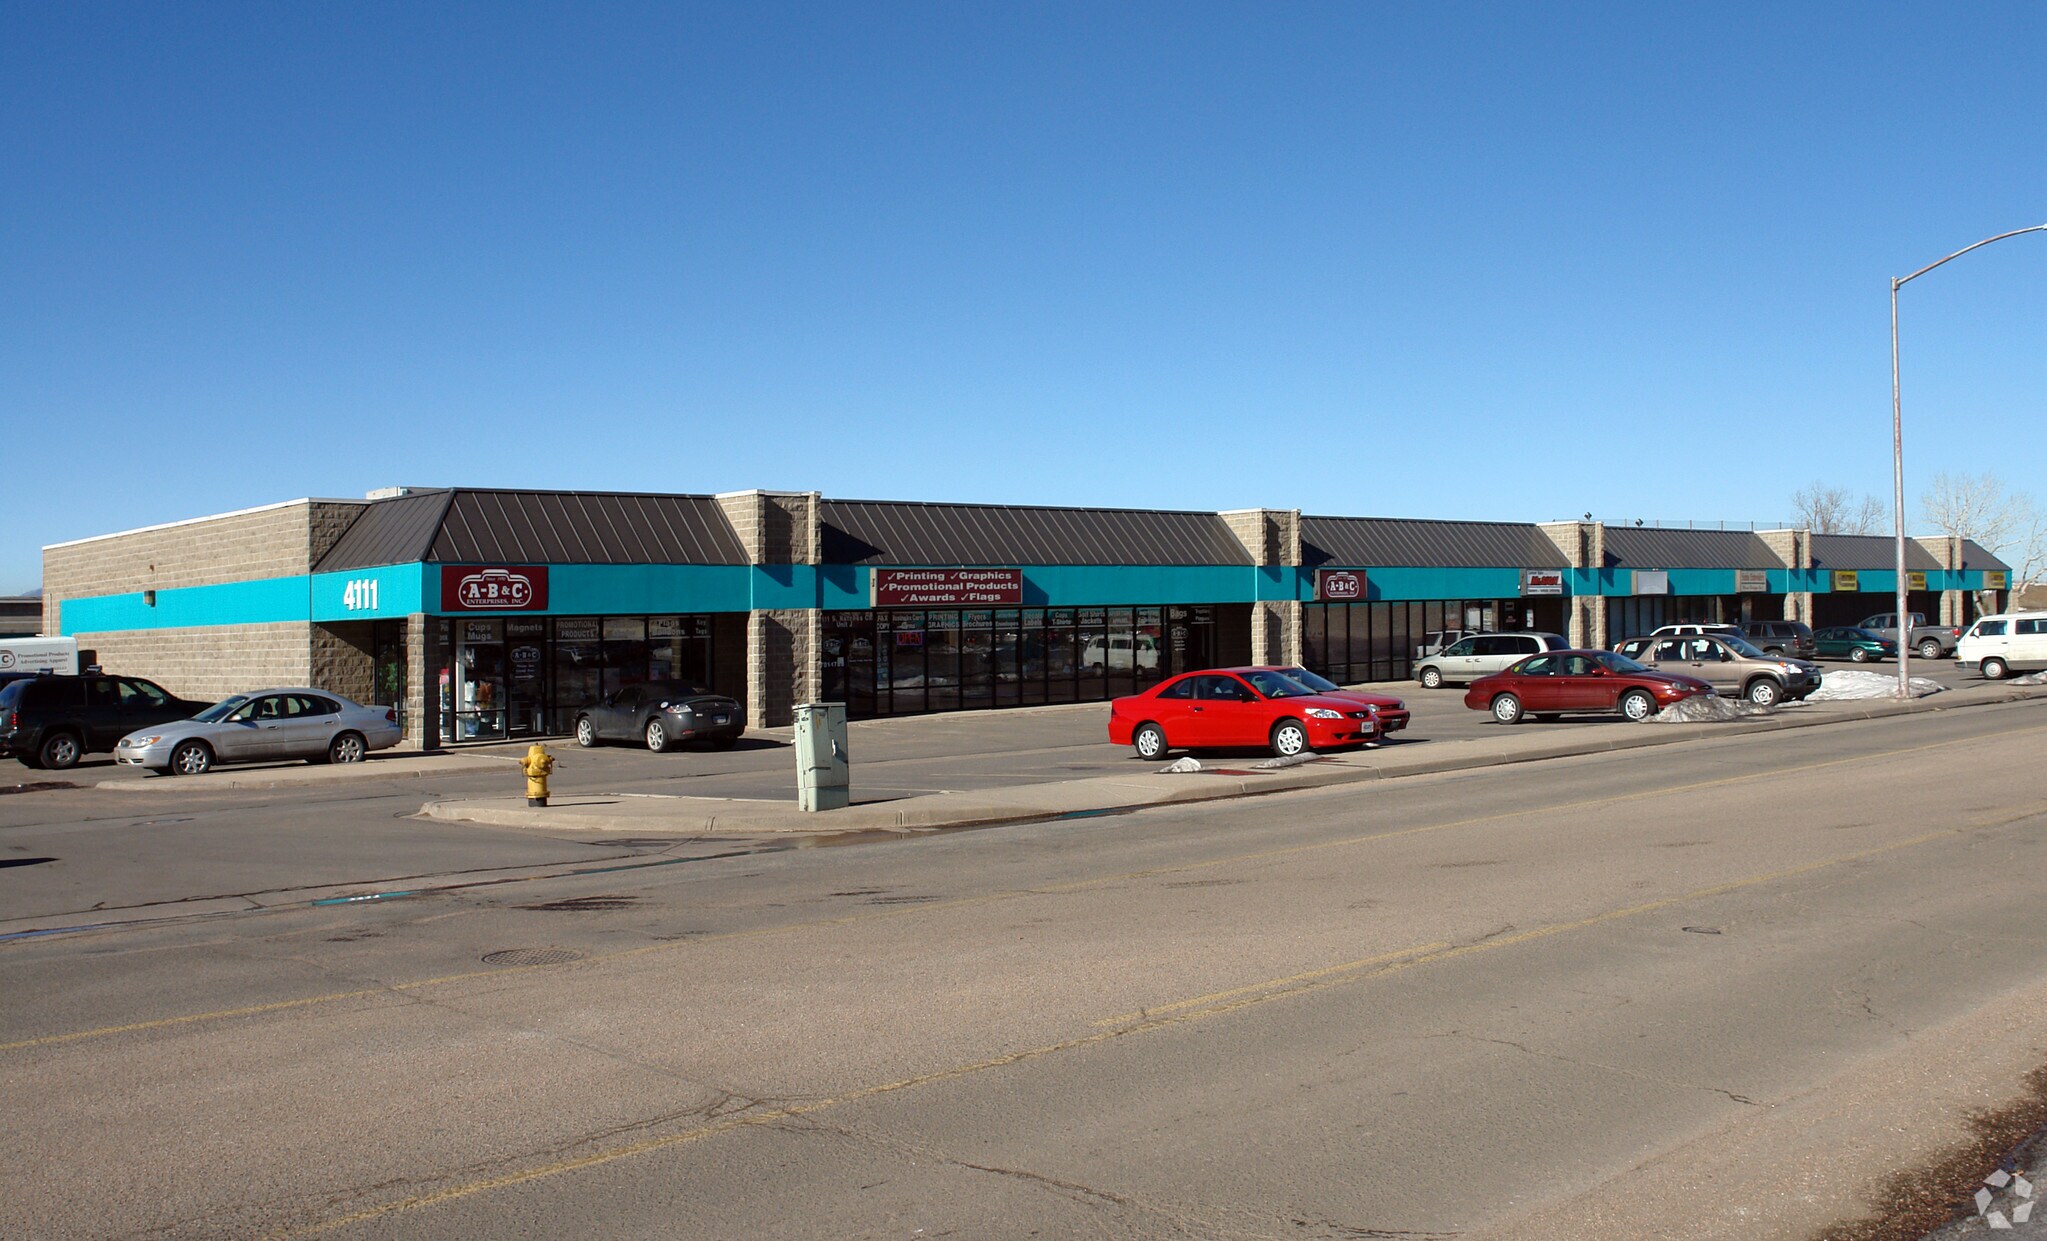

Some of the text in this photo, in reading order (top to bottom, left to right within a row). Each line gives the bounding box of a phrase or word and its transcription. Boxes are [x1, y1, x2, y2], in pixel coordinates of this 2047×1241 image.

[896, 572, 1012, 581] Printing Graphics
[889, 582, 1018, 591] Promotional Products
[344, 579, 378, 610] 4111
[910, 593, 1001, 602] Awards Flags
[968, 613, 986, 621] Flyers
[1170, 608, 1188, 619] Bags
[468, 623, 491, 632] Cups
[507, 623, 543, 633] Magnets
[556, 621, 598, 629] PROMOTIONAL
[467, 632, 492, 641] Mugs
[561, 630, 595, 638] PRODUCTS
[898, 632, 920, 644] OPEN
